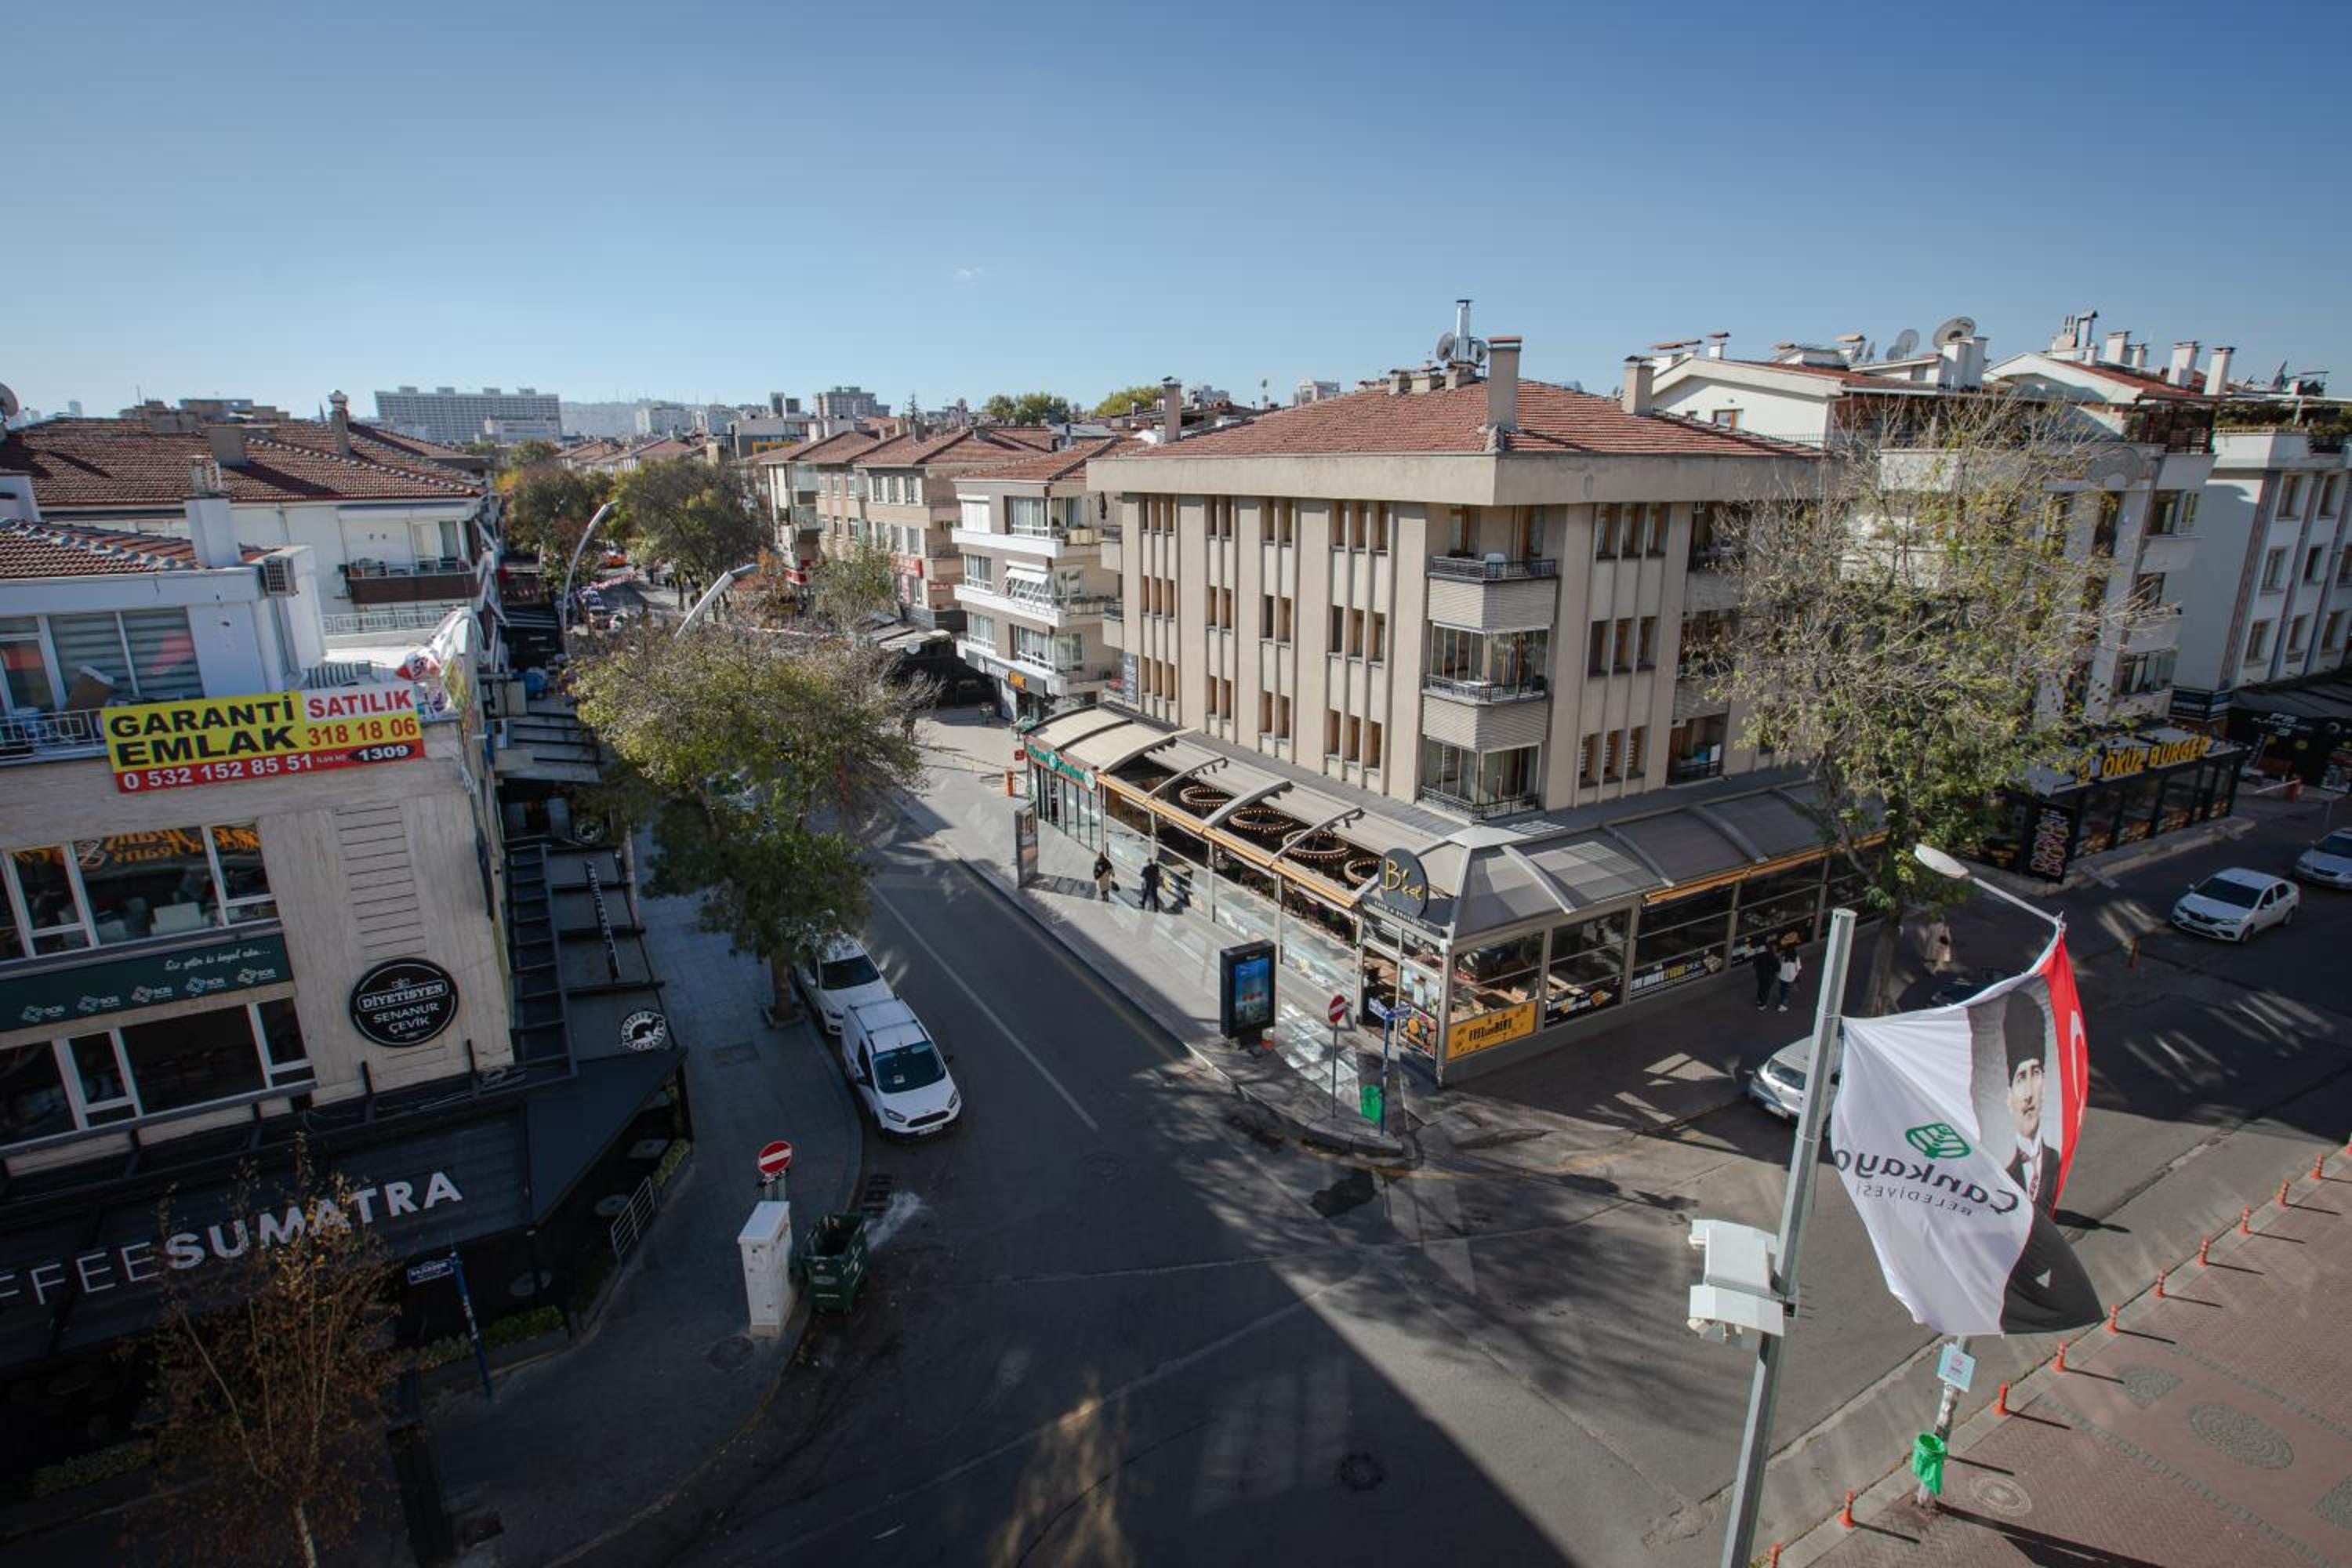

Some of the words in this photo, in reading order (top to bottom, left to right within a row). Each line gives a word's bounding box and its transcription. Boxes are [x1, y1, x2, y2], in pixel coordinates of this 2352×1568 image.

[111, 695, 296, 738] GARANTİ
[307, 689, 412, 719] SATILIK
[115, 725, 299, 767] EMLAK
[307, 724, 350, 746] 318
[357, 720, 383, 742] 18
[390, 717, 417, 739] 06
[358, 745, 410, 761] 1309
[2149, 735, 2209, 768] BURGER
[123, 772, 139, 789] 0
[147, 767, 193, 786] 532
[199, 762, 245, 782] 152
[250, 758, 279, 775] 85
[286, 753, 313, 771] 51
[362, 983, 444, 1009] DİYETİSYEN
[374, 1003, 440, 1023] SENANUR
[388, 1016, 430, 1034] ÇEVİK
[165, 1171, 463, 1269] SUMATRA
